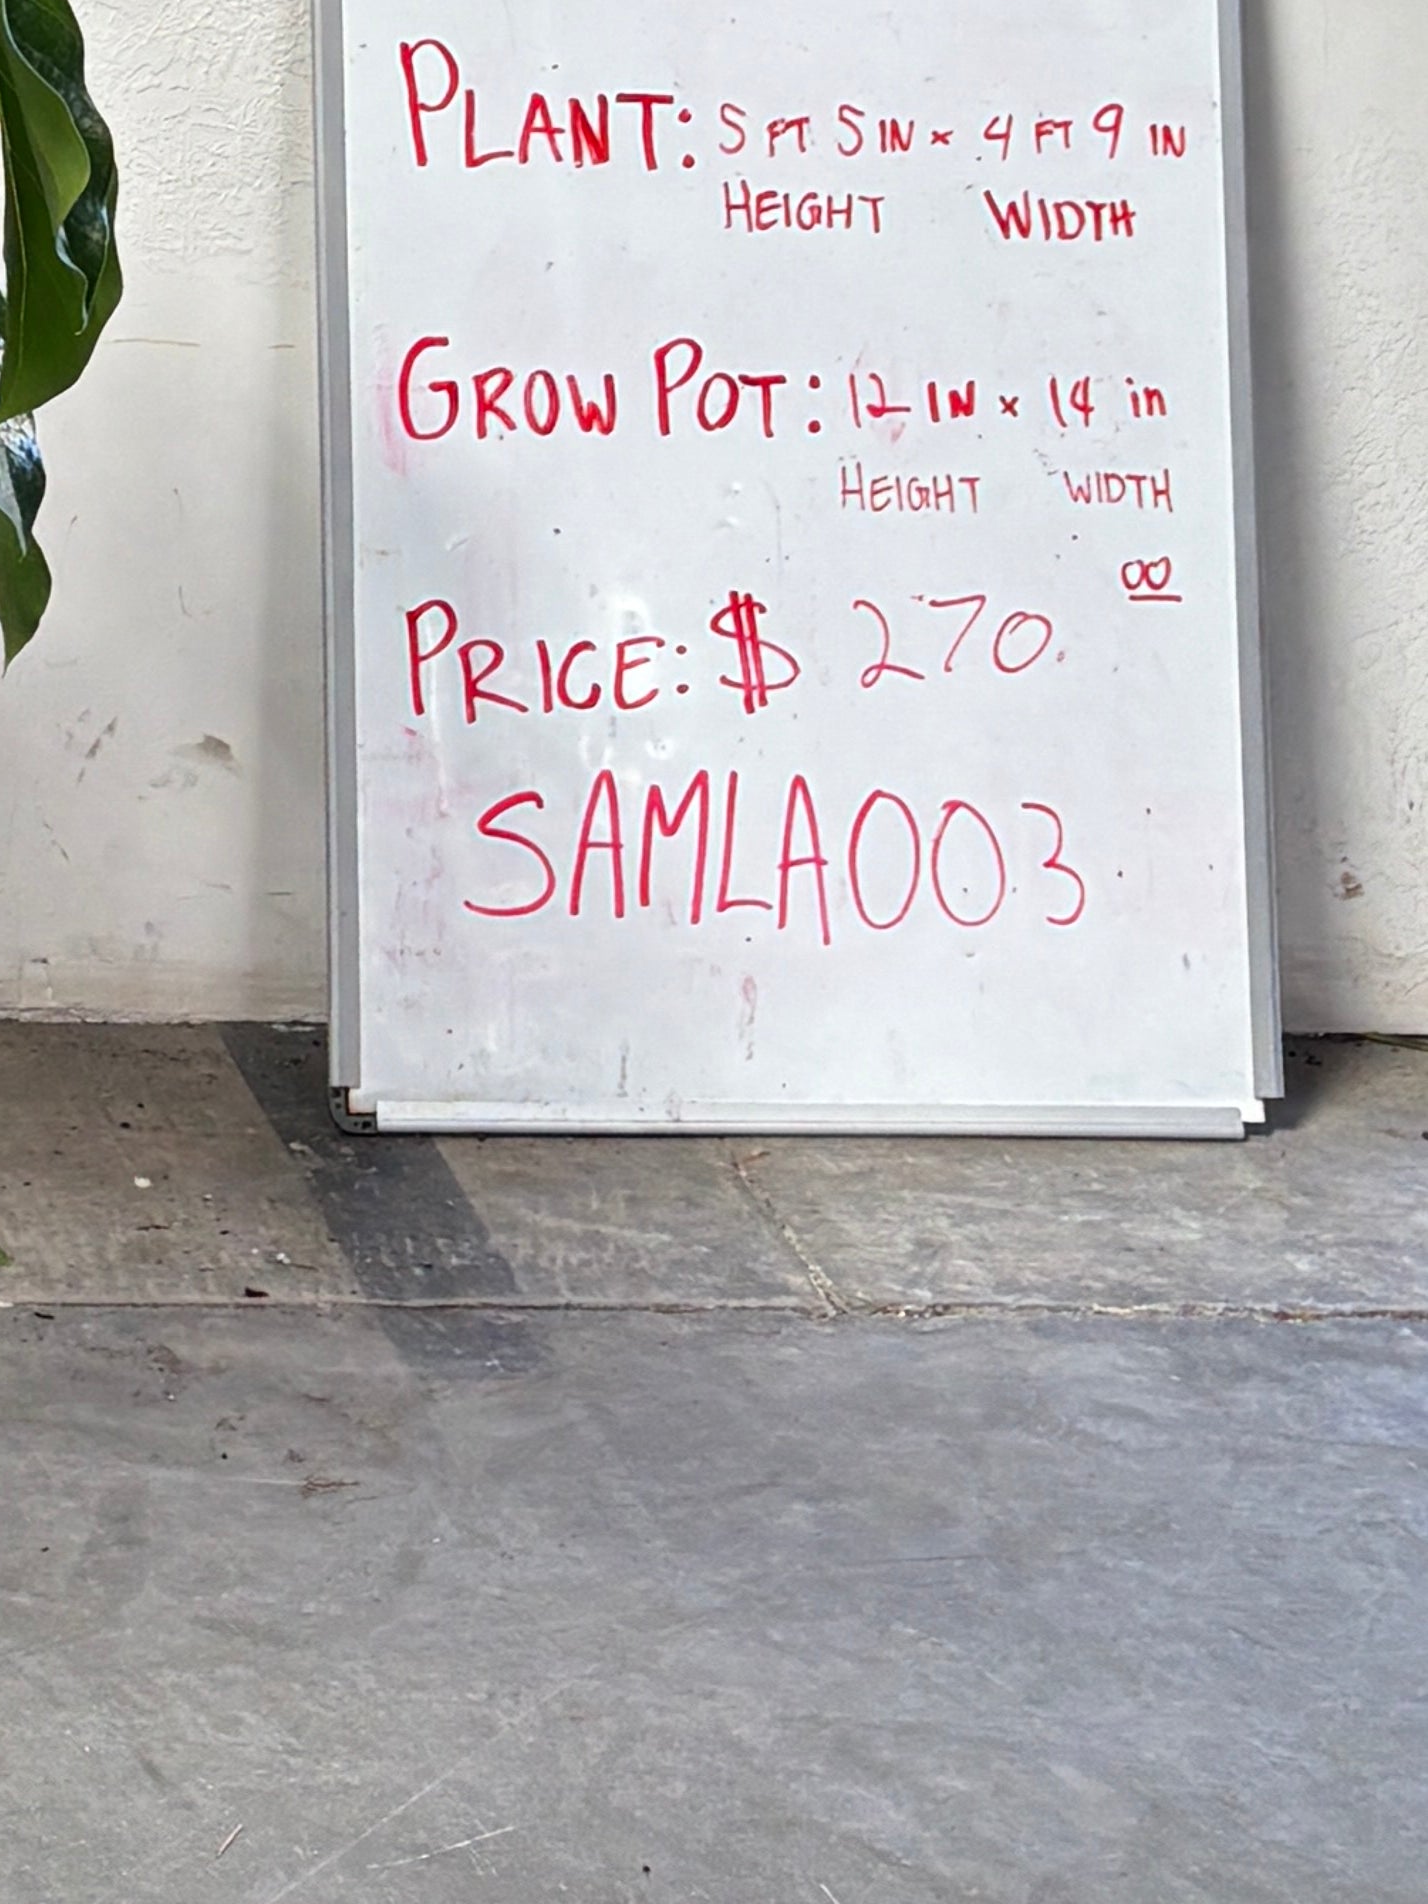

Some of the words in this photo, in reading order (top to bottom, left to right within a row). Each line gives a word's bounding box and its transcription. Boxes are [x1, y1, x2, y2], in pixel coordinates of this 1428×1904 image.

[398, 38, 696, 173] PLANT:
[765, 116, 811, 158] FT
[877, 118, 915, 154] IN
[981, 113, 1015, 161] 4
[1033, 116, 1075, 153] FT
[1090, 102, 1125, 157] 9
[1147, 124, 1187, 160] IN
[722, 179, 886, 234] HEIGHT
[982, 191, 1136, 242] WIDTH
[396, 335, 619, 443] GROW
[651, 336, 822, 439] POT:
[846, 372, 909, 426] 12
[925, 380, 977, 424] IN
[1047, 377, 1095, 428] 14
[1124, 376, 1169, 419] in
[839, 462, 982, 514] HEIGHT
[1062, 467, 1174, 513] WIDTH
[403, 598, 689, 725] PRICE:
[707, 590, 801, 716] $
[463, 768, 1086, 946] SAMLA003
